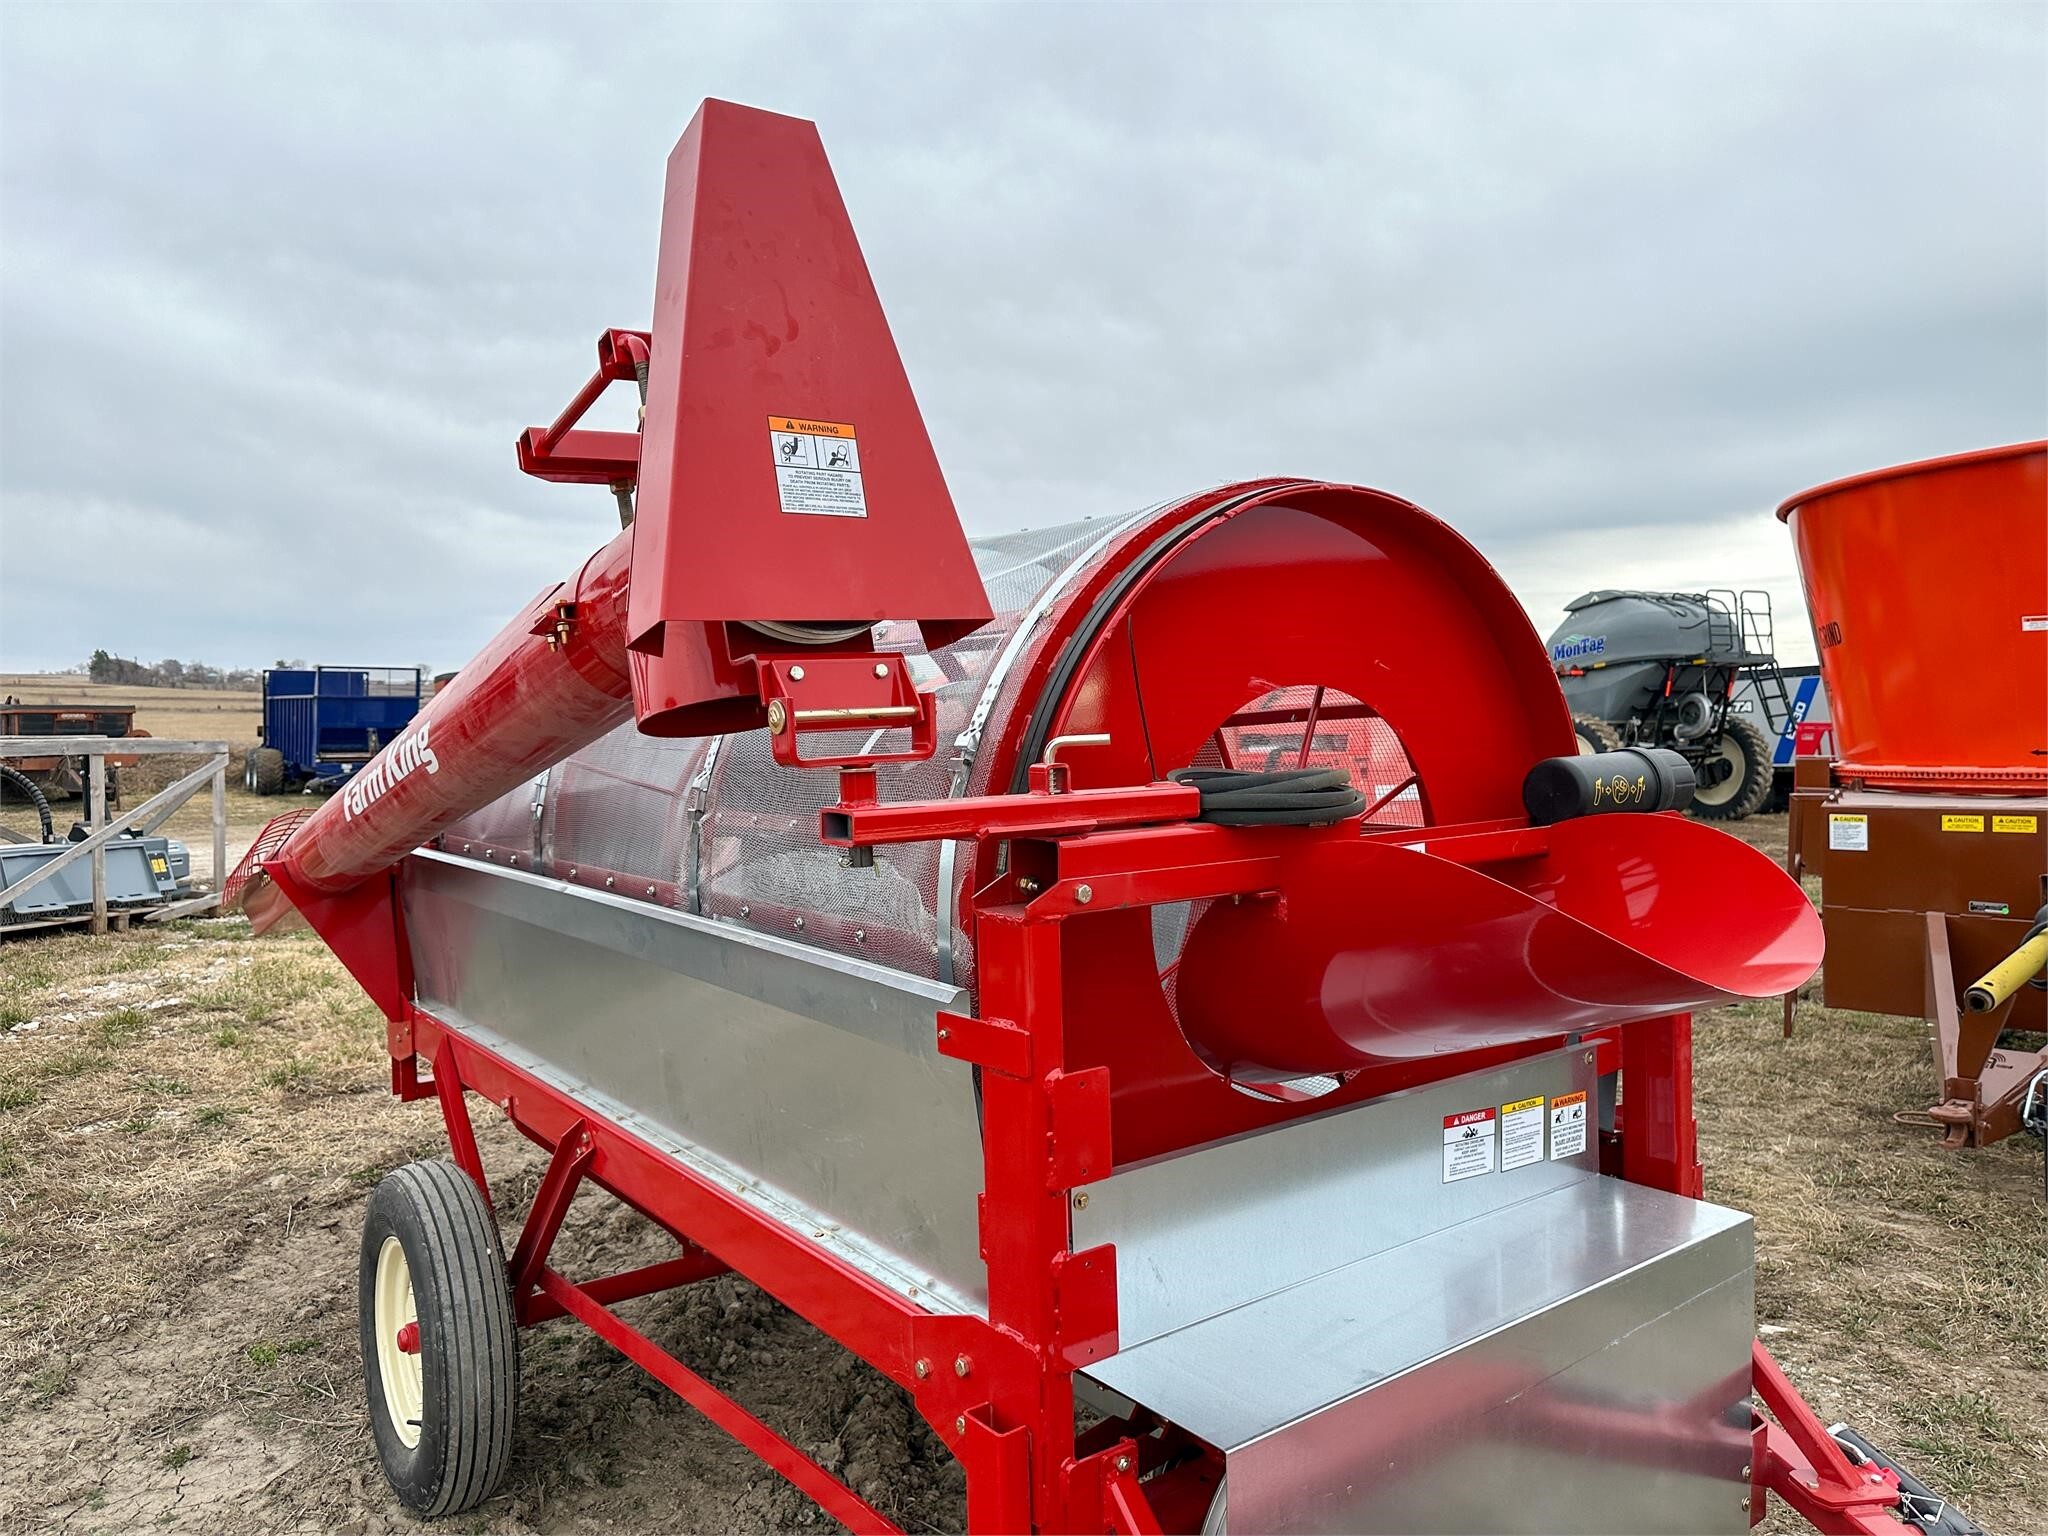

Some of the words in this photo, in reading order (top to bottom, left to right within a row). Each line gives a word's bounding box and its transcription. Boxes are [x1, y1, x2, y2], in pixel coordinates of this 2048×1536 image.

[798, 423, 839, 434] WARNING
[1553, 637, 1605, 660] MonTag
[343, 764, 387, 822] Farm
[385, 720, 439, 789] King
[1517, 1100, 1537, 1108] CAUTION
[1559, 1094, 1584, 1106] WARNING
[1461, 1112, 1486, 1123] DANGER
